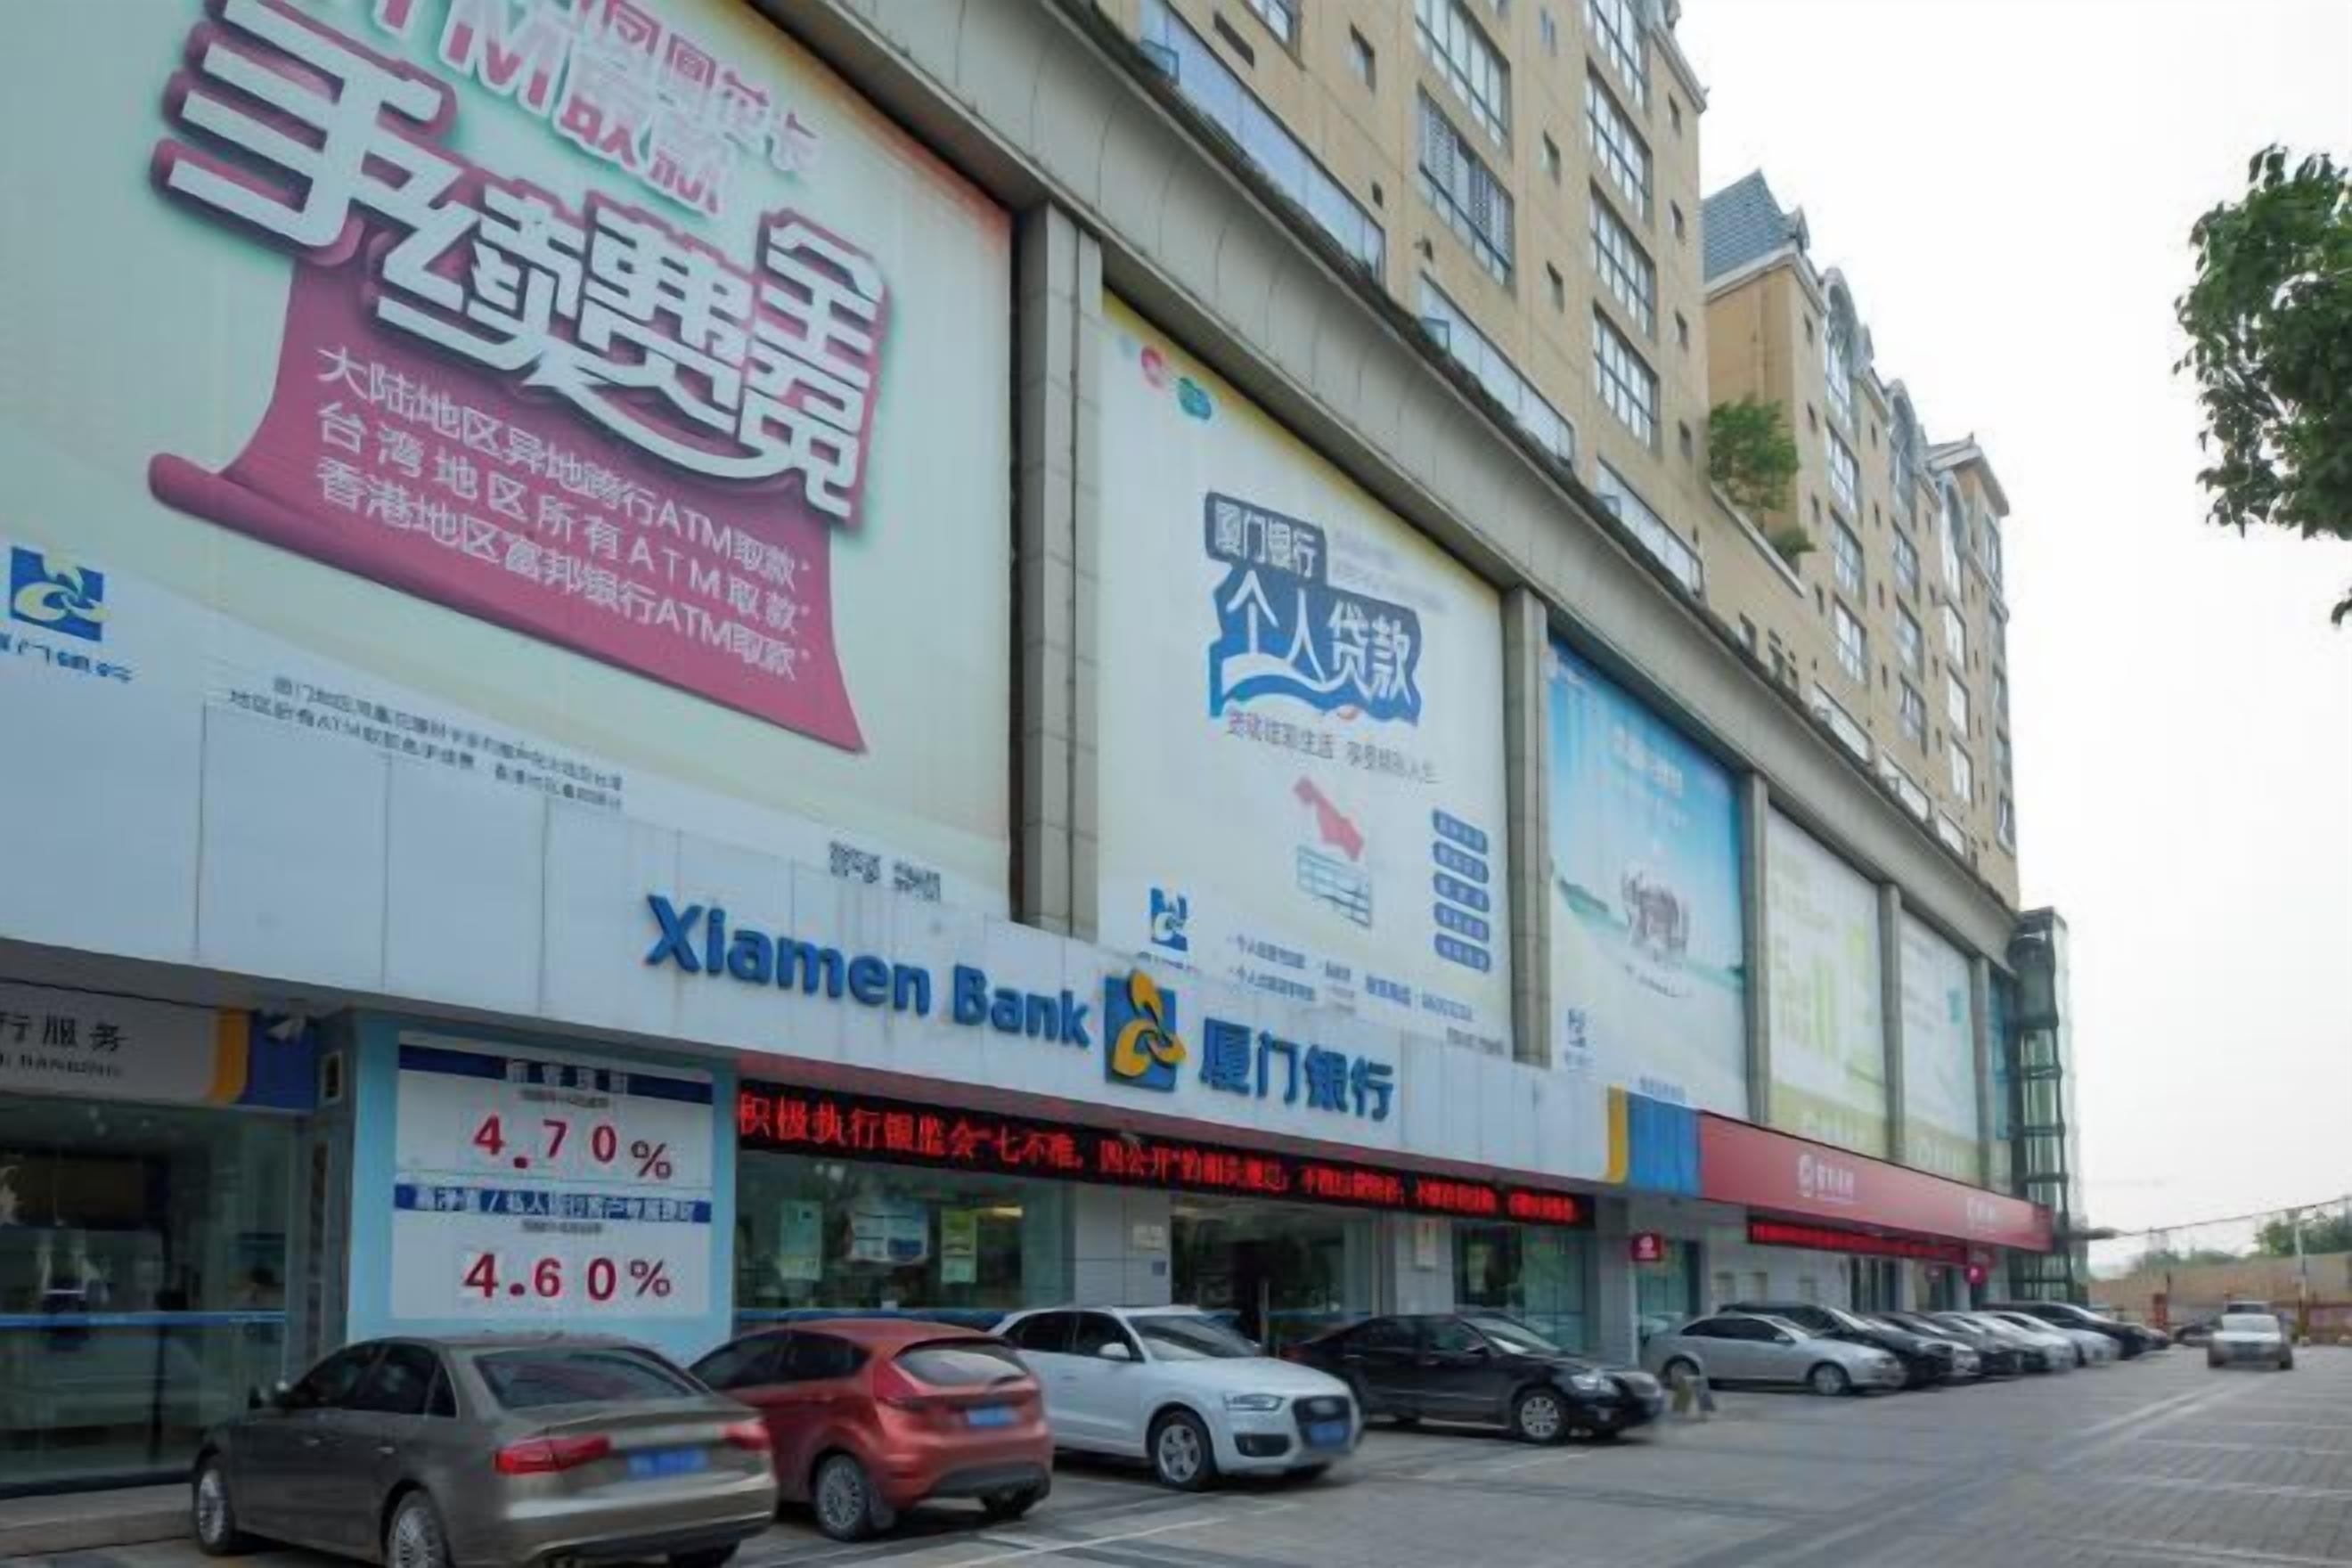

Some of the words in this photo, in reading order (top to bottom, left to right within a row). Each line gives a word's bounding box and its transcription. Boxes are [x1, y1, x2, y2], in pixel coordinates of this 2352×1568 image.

[1221, 568, 1415, 707] 个人贷款
[646, 894, 932, 1017] Xiamen
[951, 964, 1093, 1050] Bank
[1197, 1017, 1395, 1123] 厦门银行
